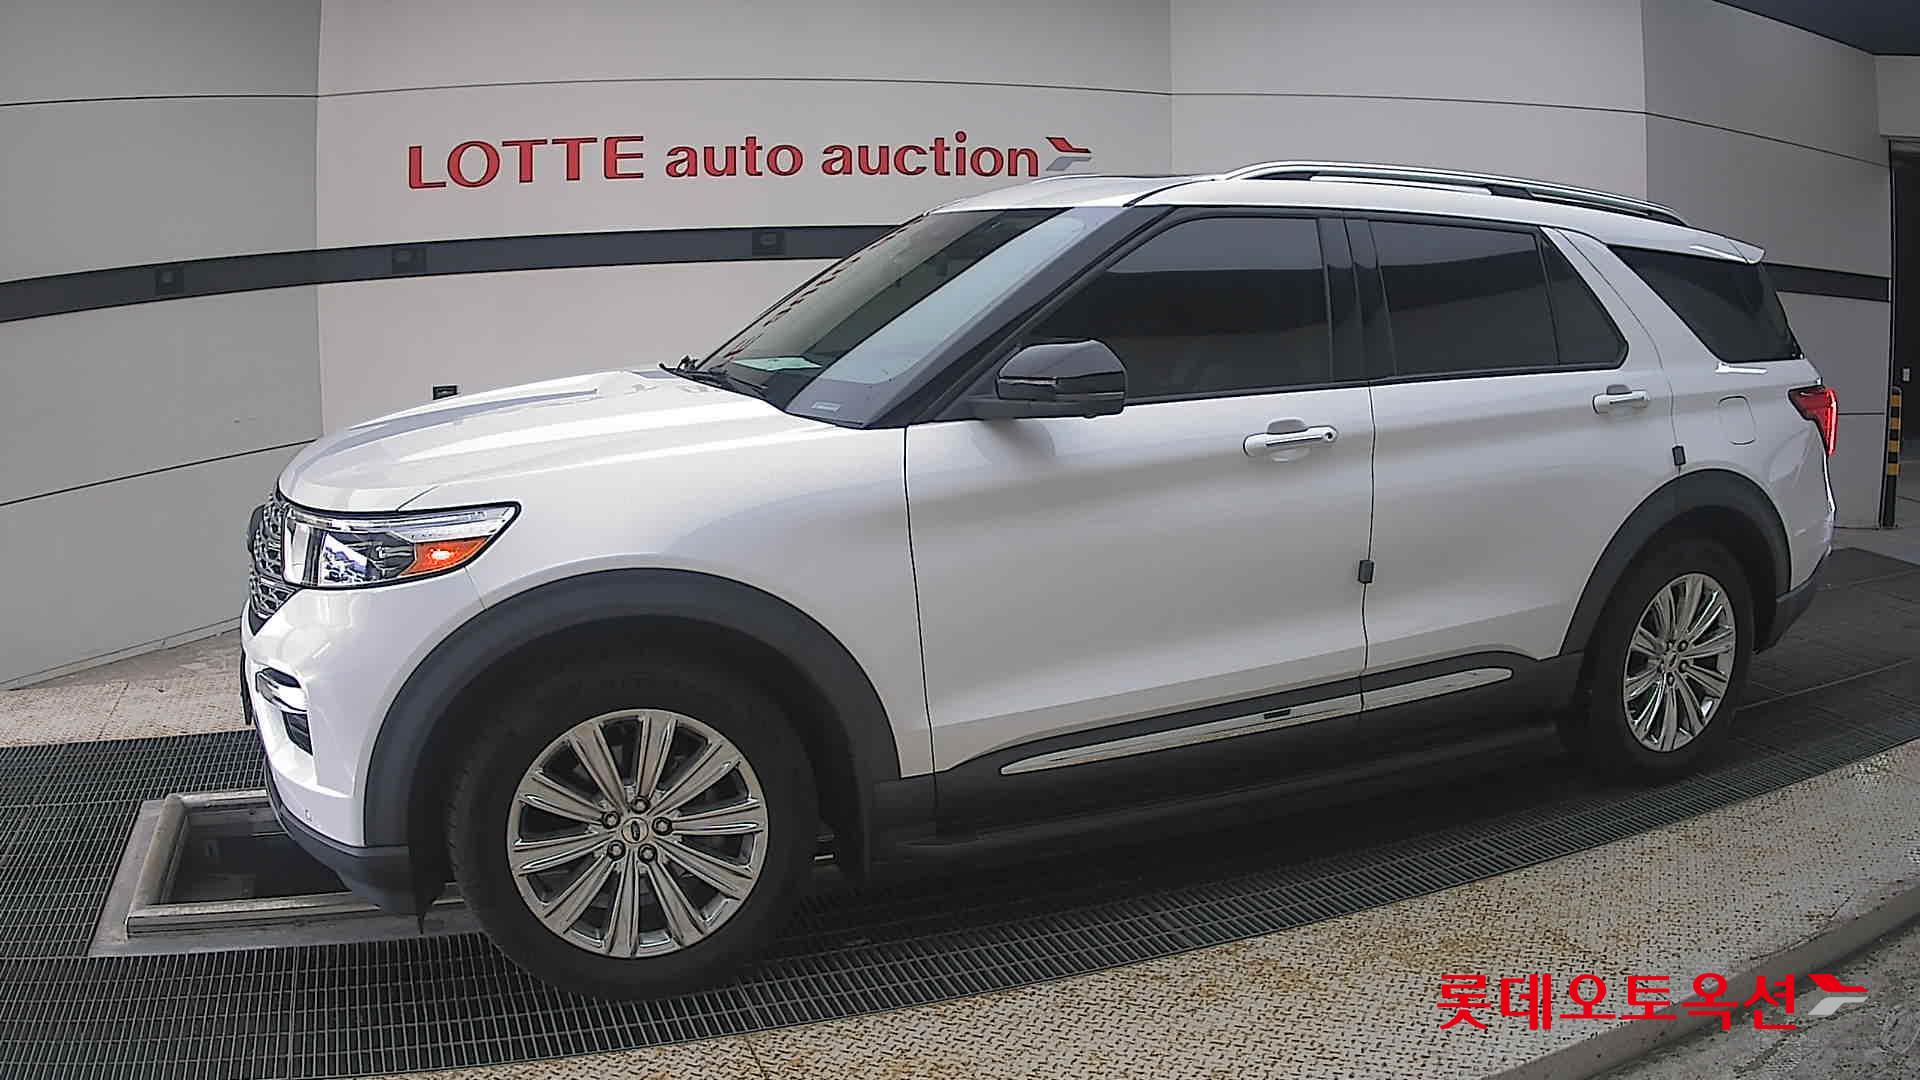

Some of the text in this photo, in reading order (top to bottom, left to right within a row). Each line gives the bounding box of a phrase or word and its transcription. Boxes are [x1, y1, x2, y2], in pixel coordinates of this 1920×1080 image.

[408, 131, 1040, 190] LOTTE auto auction
